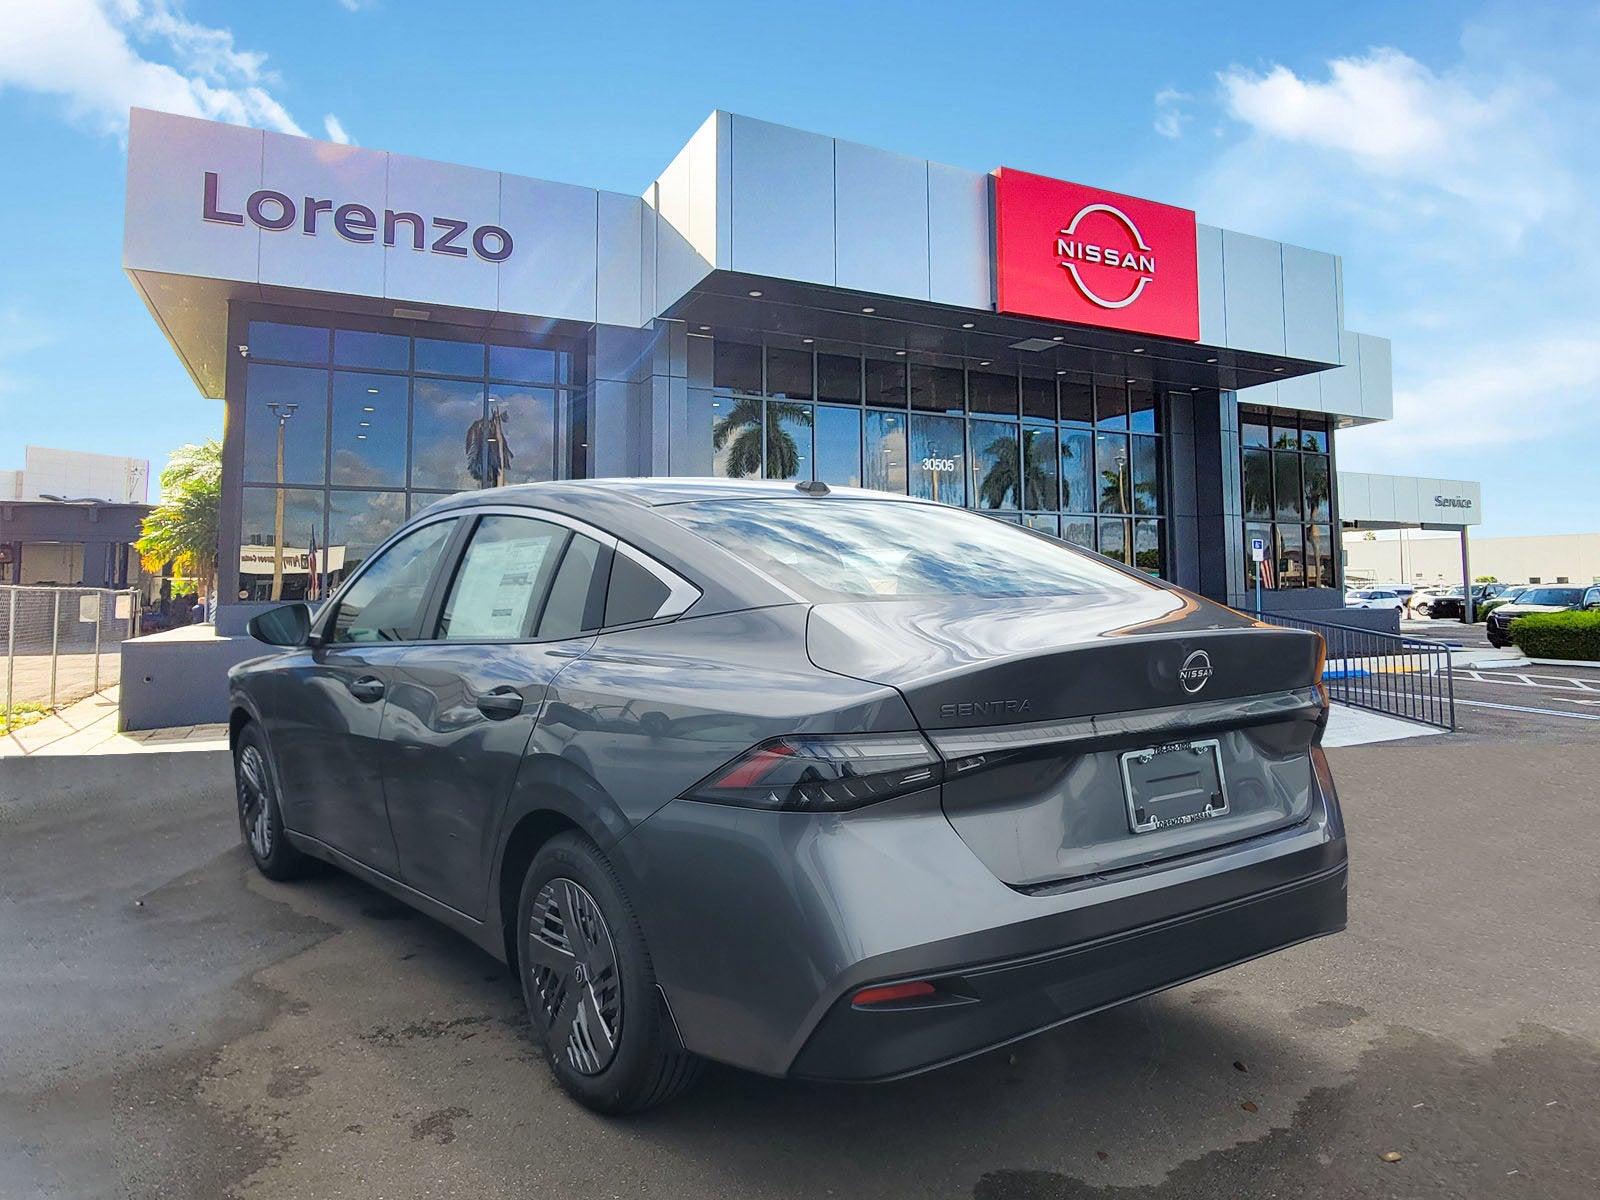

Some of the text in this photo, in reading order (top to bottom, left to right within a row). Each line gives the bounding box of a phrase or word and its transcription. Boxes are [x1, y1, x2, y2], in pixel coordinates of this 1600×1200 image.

[202, 171, 514, 263] Lorenzo
[1057, 238, 1155, 273] NISSAN
[922, 457, 954, 471] 30505
[1434, 495, 1472, 509] Service
[1179, 668, 1213, 679] NISSAN
[940, 699, 1032, 718] SENTRA
